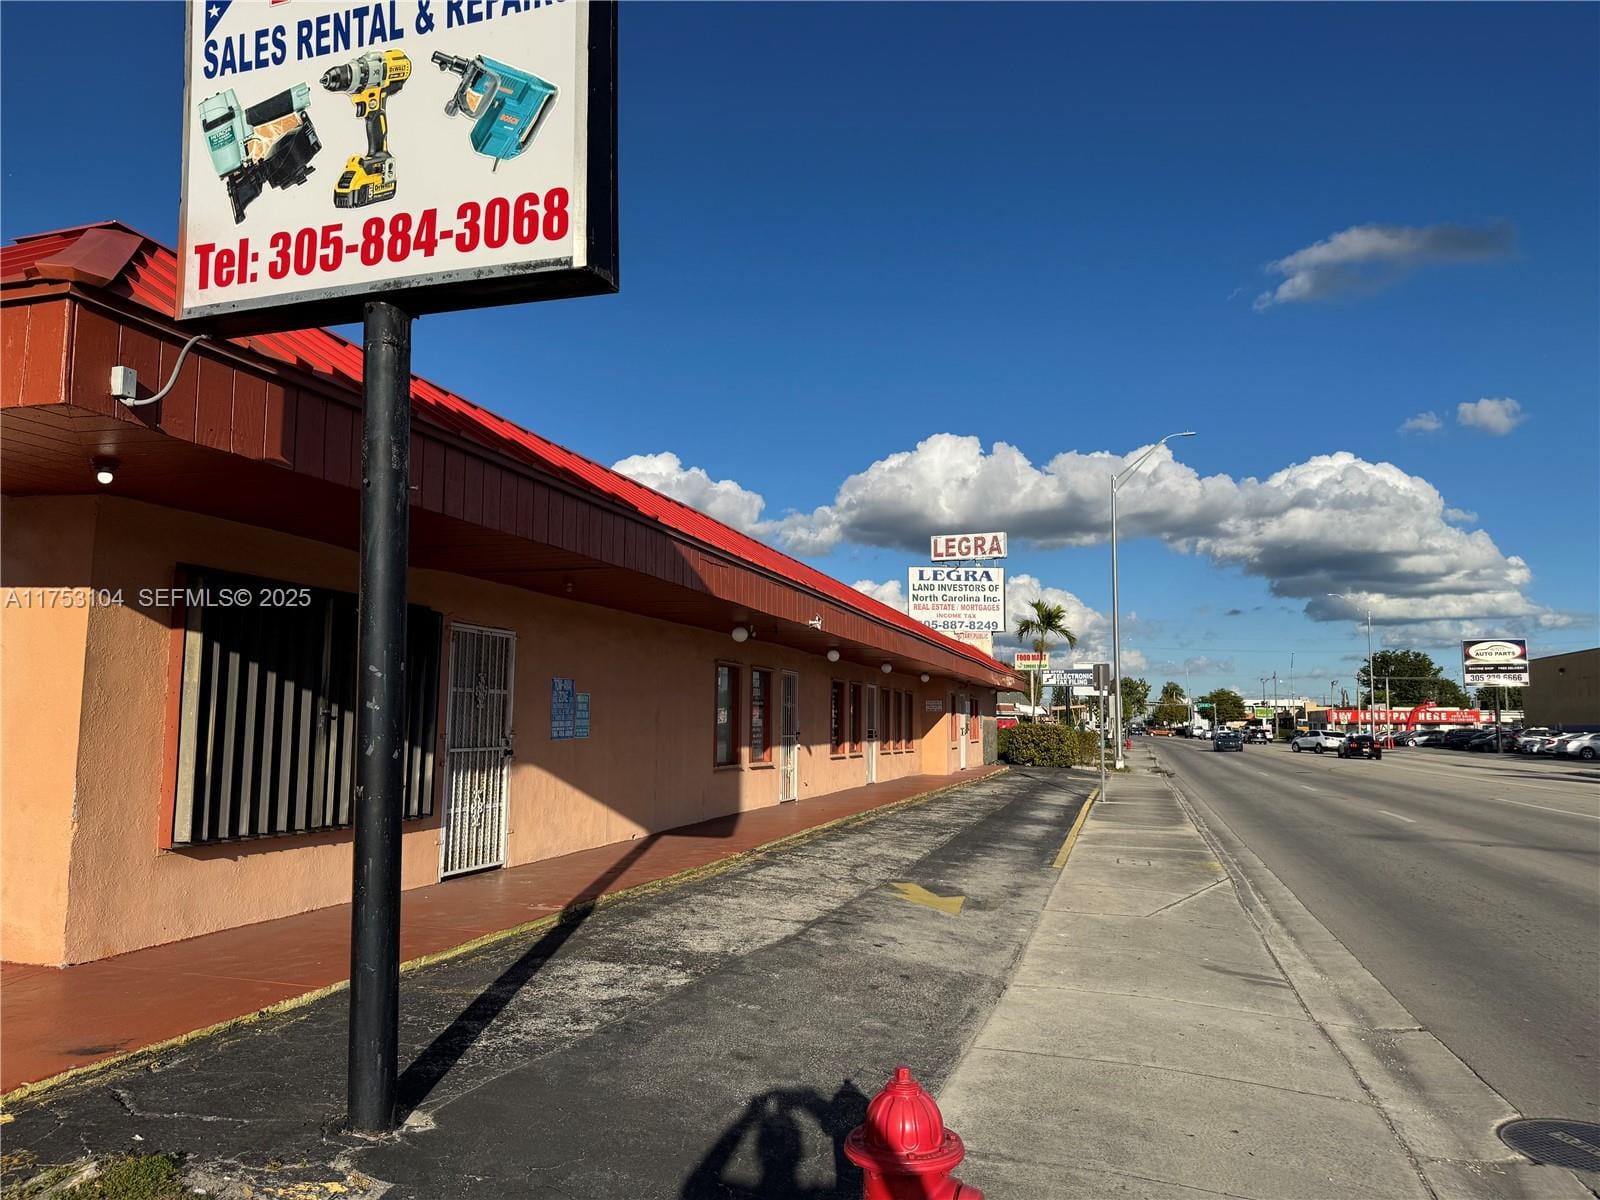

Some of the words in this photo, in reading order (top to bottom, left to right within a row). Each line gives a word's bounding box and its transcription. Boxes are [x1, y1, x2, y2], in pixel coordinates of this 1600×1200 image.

[203, 25, 287, 79] SALES
[297, 0, 404, 61] RENTAL
[415, 0, 434, 35] &
[194, 238, 259, 290] Tel:
[268, 187, 570, 280] 305-884-3068
[933, 535, 1003, 558] LEGRA
[918, 569, 993, 582] LEGRA
[912, 583, 935, 592] LAND
[937, 584, 986, 592] INVESTORS
[988, 584, 1000, 593] OF
[912, 593, 939, 602] North
[941, 593, 981, 602] Carolina
[983, 594, 1001, 602] Inc.
[913, 603, 930, 611] REAL
[931, 603, 955, 611] ESTATE
[960, 604, 1000, 612] MORTGAGES
[920, 620, 999, 630] 05-887-8249
[1016, 654, 1031, 662] FOOD
[1031, 654, 1047, 662] MAT
[1470, 674, 1485, 682] 305
[1418, 712, 1447, 721] HERE
